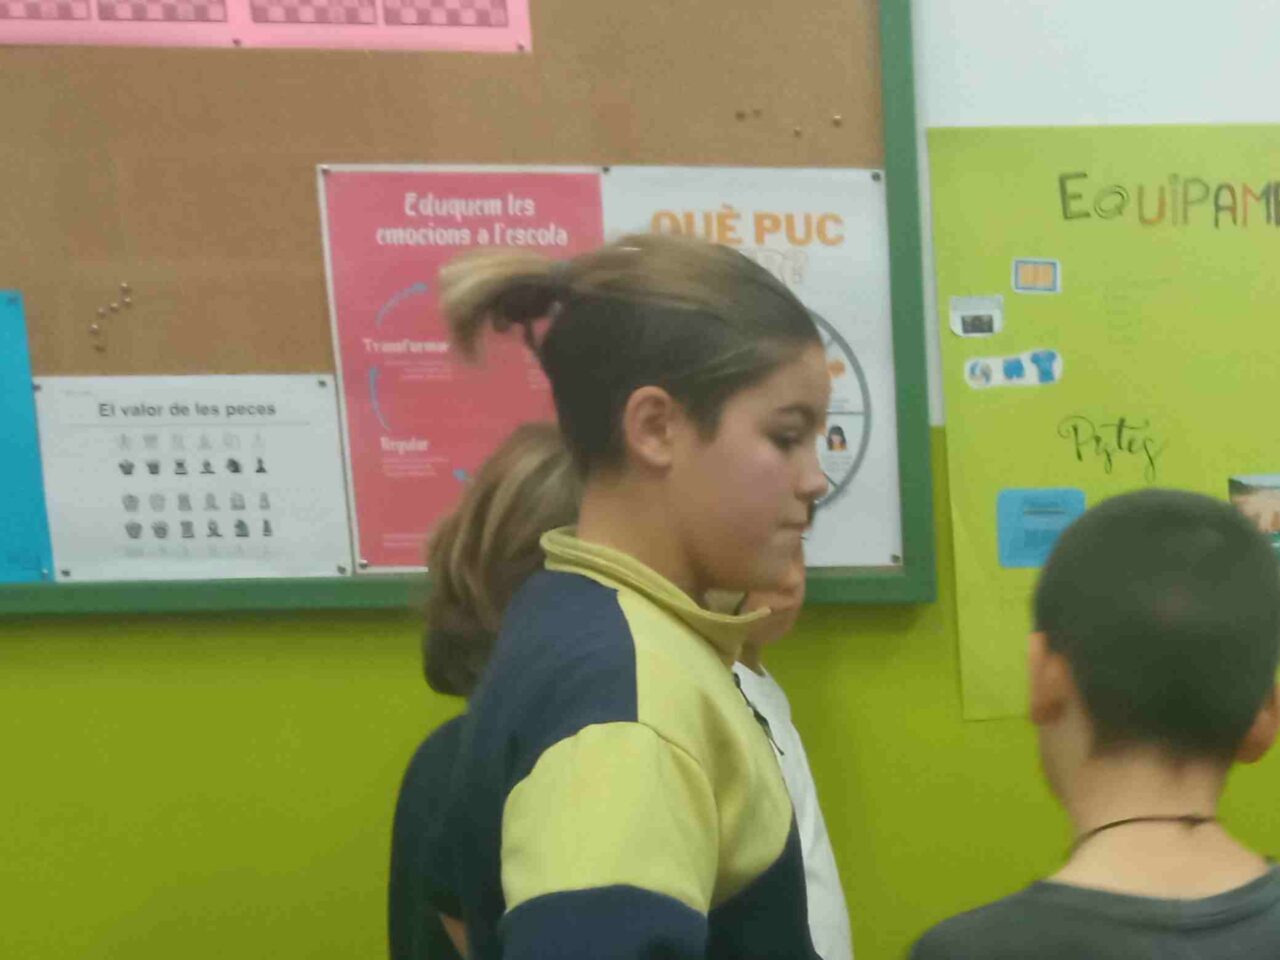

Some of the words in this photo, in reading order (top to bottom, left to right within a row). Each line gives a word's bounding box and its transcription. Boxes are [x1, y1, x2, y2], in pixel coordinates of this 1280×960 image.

[404, 192, 502, 222] Eduquem
[508, 193, 536, 216] les
[376, 222, 471, 246] emocions
[477, 227, 489, 245] a
[494, 222, 568, 246] l'escola
[753, 210, 844, 247] PUC
[98, 403, 116, 417] El
[121, 403, 164, 417] valor
[169, 403, 190, 417] de
[196, 402, 220, 416] les
[226, 403, 277, 418] peces
